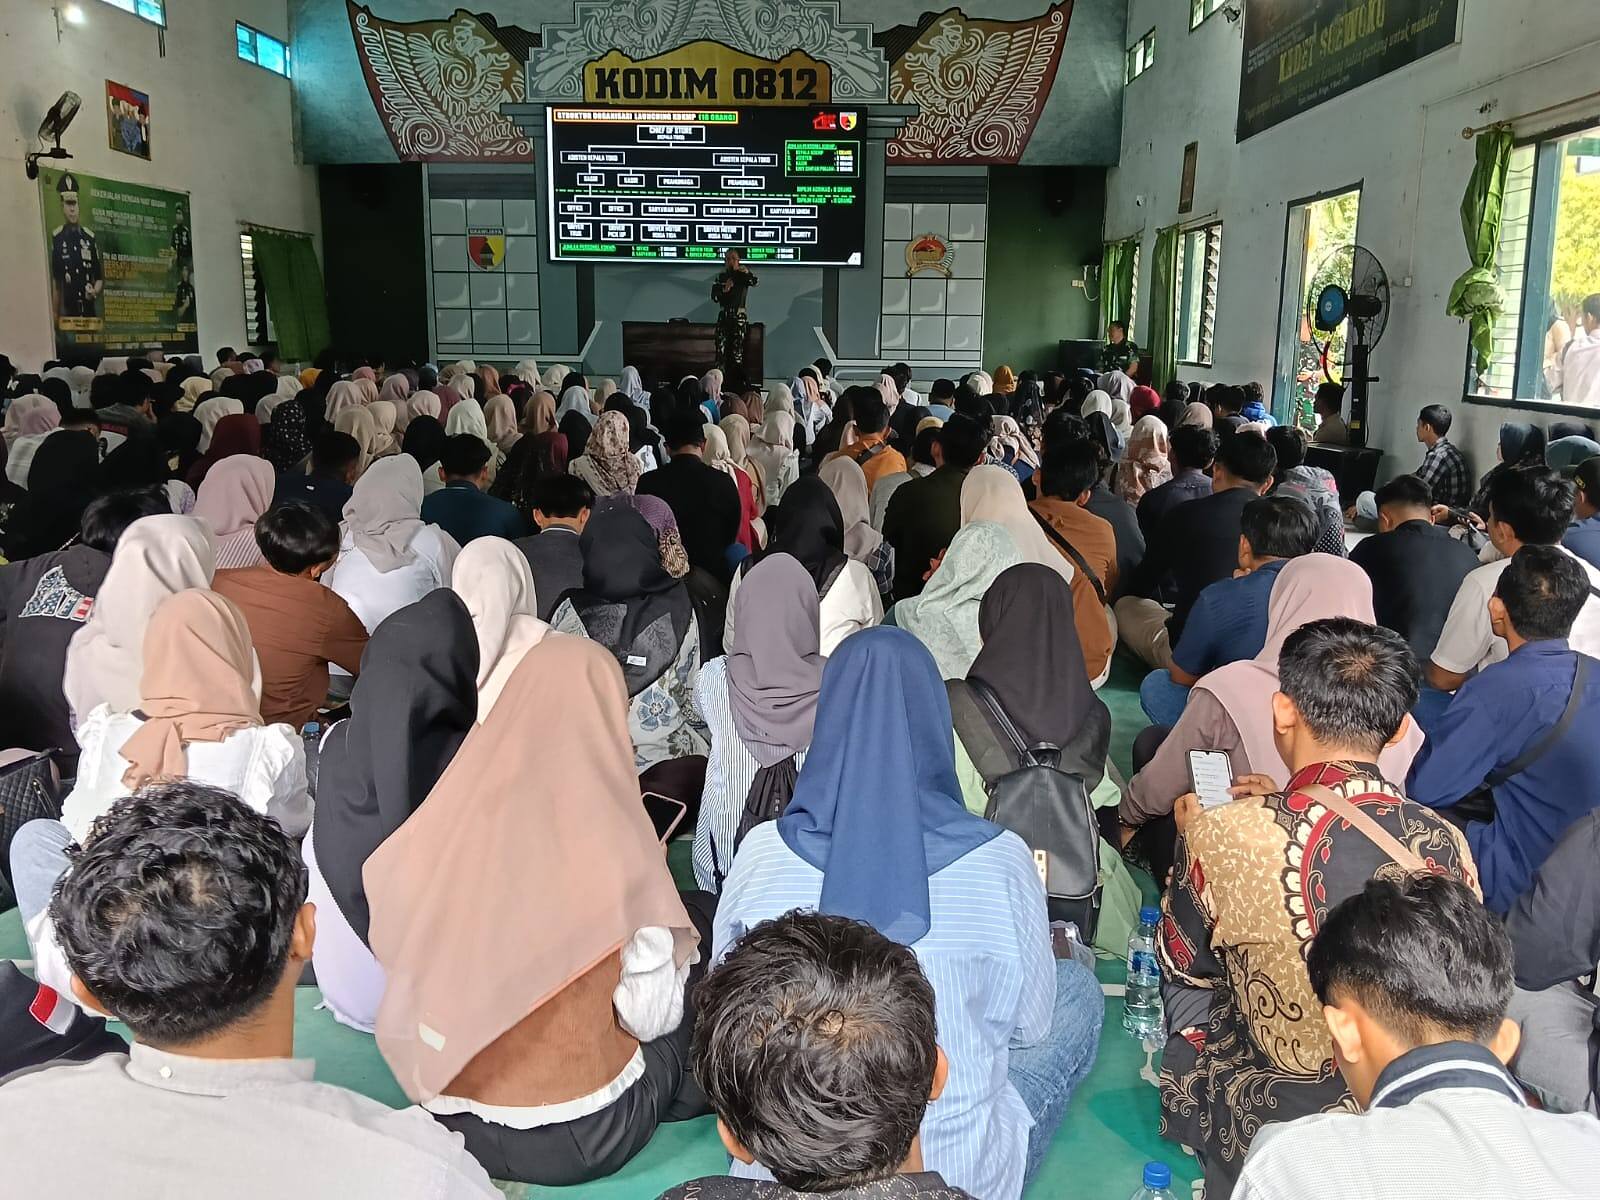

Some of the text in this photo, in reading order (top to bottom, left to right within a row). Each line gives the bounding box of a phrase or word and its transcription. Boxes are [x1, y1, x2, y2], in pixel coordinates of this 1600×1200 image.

[595, 68, 817, 99] KODIM 0812
[634, 113, 672, 121] LAUNCHING
